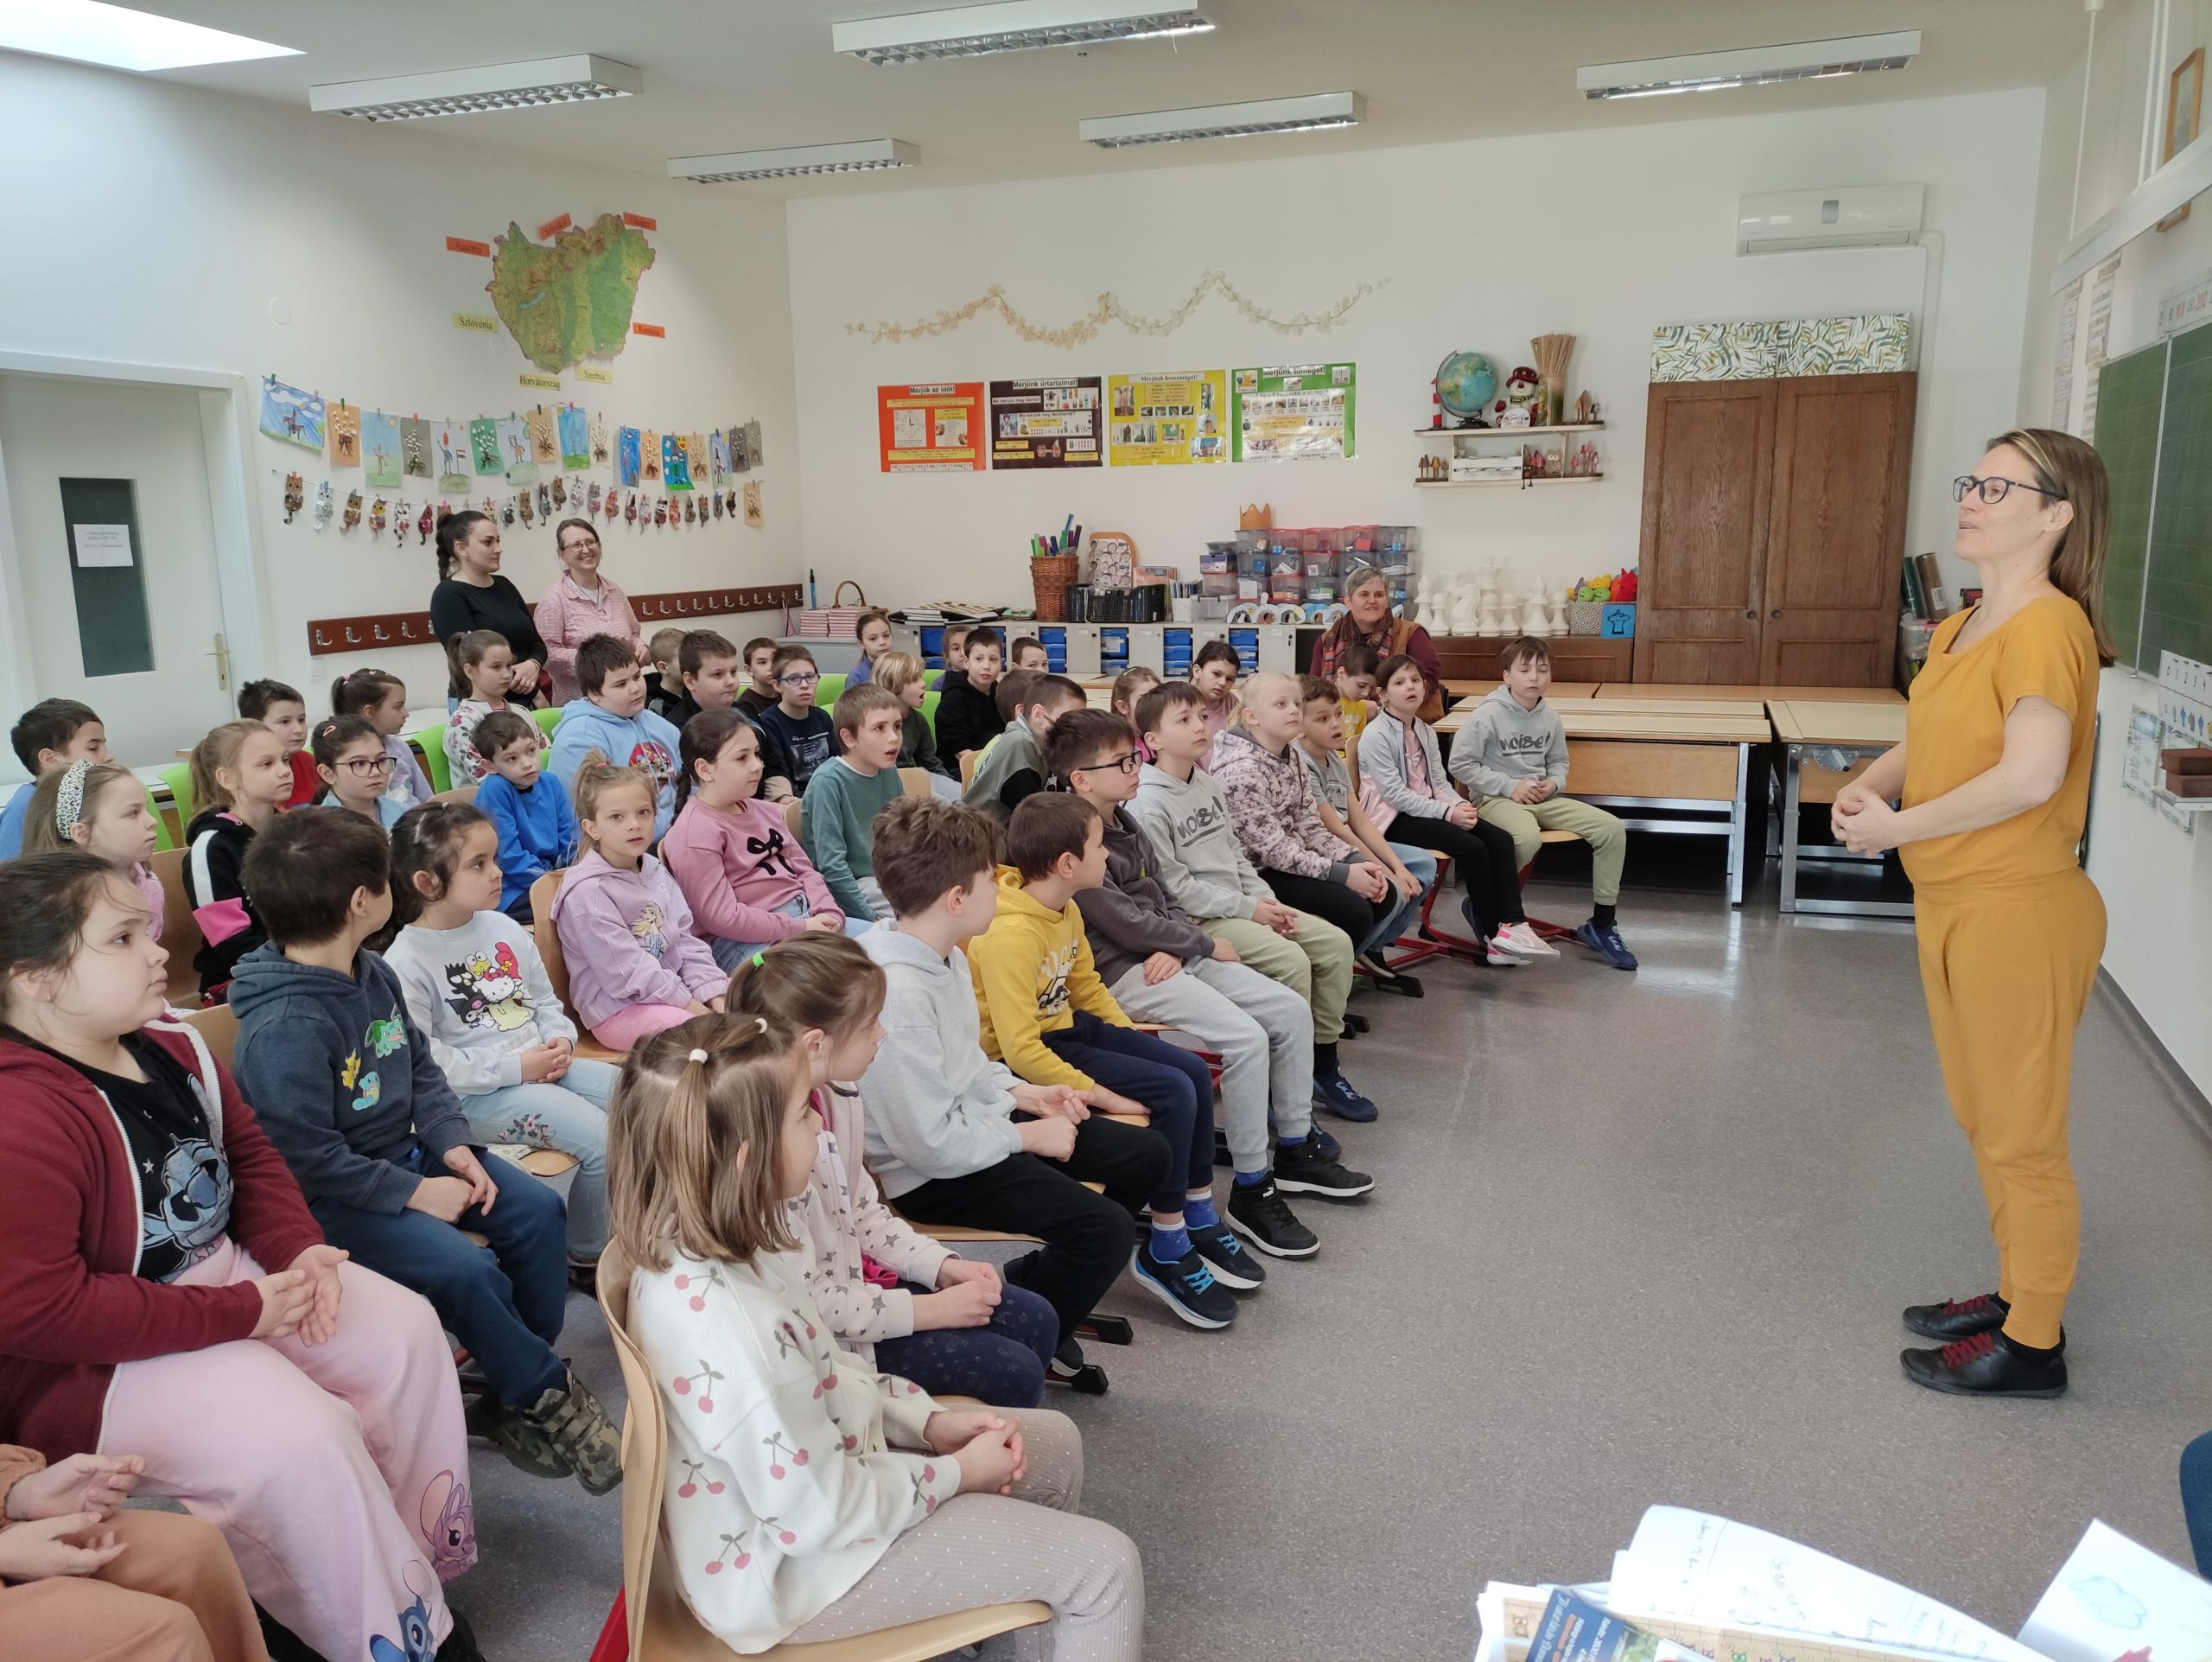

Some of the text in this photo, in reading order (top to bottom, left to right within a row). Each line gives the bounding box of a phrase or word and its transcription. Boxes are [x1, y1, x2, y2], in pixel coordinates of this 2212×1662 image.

[459, 316, 493, 330] Szlovénia
[583, 369, 606, 381] Szerbia
[519, 375, 561, 390] Horvátország
[1013, 380, 1039, 389] Mérjünk
